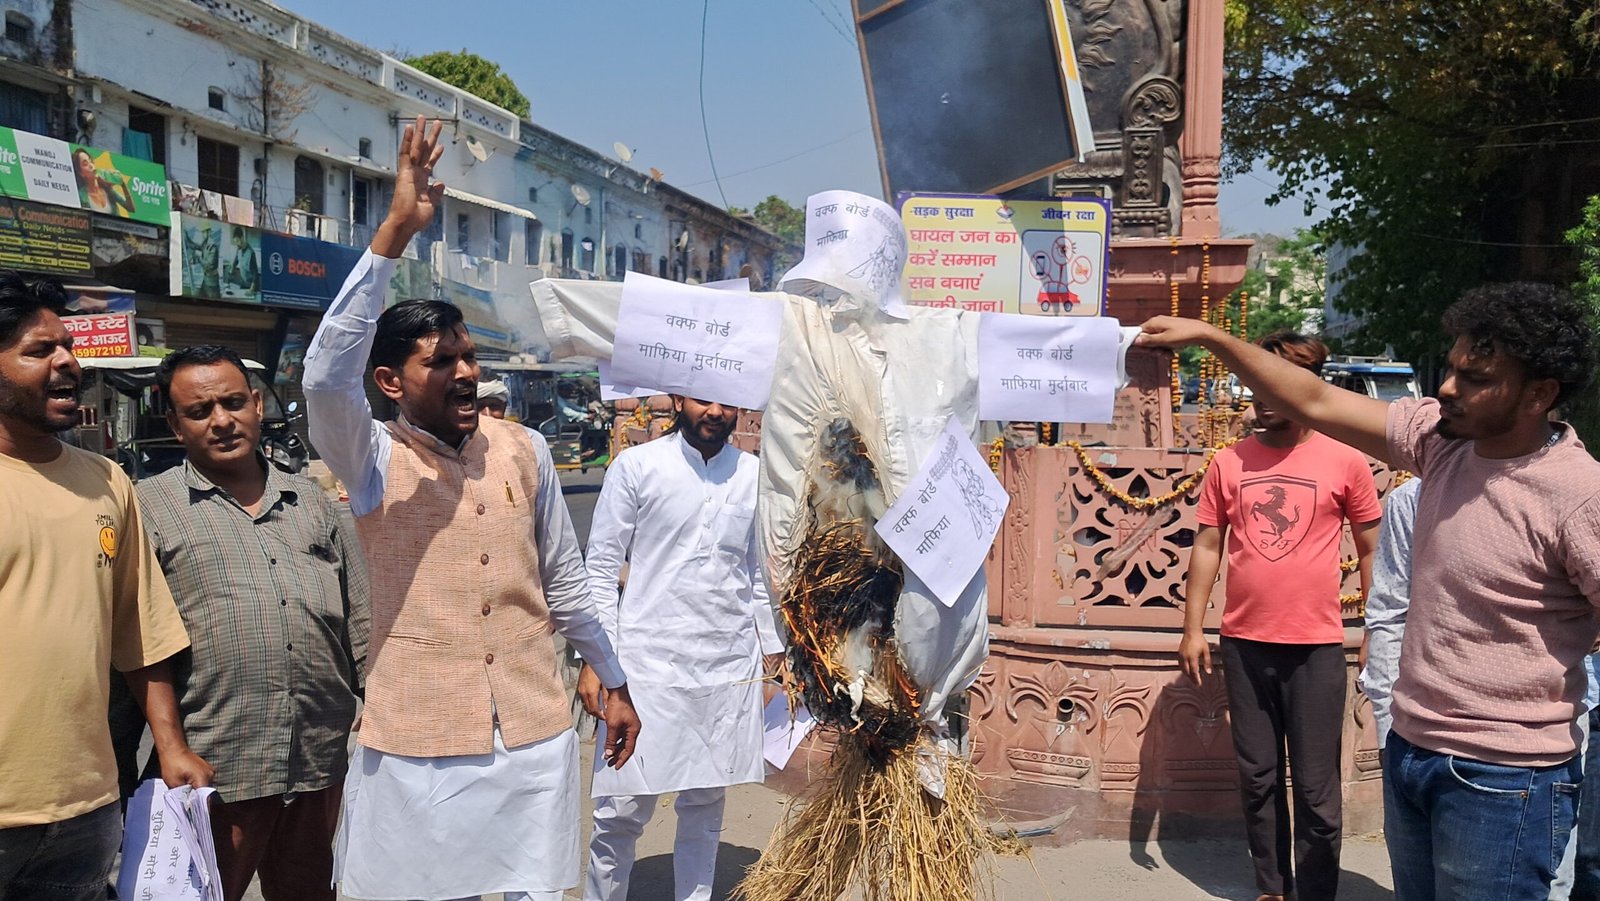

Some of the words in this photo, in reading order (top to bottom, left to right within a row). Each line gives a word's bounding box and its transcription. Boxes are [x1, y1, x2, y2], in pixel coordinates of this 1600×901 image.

[34, 148, 56, 159] MANOJ
[22, 155, 73, 172] COMMUNICATION
[33, 178, 50, 188] DAILY
[51, 181, 70, 192] NEEDS
[132, 176, 166, 197] Sprite
[18, 206, 90, 230] Communication
[815, 203, 839, 217] वक्फ
[845, 202, 870, 218] बोर्ड
[912, 206, 940, 219] सड़क
[944, 207, 974, 220] सुरक्षा
[1041, 208, 1070, 220] जीवन
[1075, 210, 1096, 220] रक्षा
[816, 229, 849, 247] माफिया
[910, 229, 954, 243] घायल
[960, 230, 990, 244] जन
[995, 230, 1017, 244] का
[909, 249, 939, 266] करें
[941, 253, 997, 267] सम्मान
[288, 258, 325, 278] BOSCH
[909, 276, 935, 289] सब
[941, 273, 984, 290] बचाएं
[96, 316, 126, 330] स्टेट
[666, 314, 698, 331] वक्फ
[705, 318, 731, 337] बोर्ड
[91, 333, 127, 346] आऊट
[639, 342, 687, 363] माफिया
[691, 352, 744, 373] मुर्दाबाद
[1017, 347, 1043, 360] वक्फ
[1050, 345, 1074, 360] बोर्ड
[1001, 375, 1042, 391] माफिया
[1048, 376, 1088, 395] मुर्दाबाद
[892, 505, 917, 533] वक्फ
[917, 478, 937, 505] बोर्ड
[916, 515, 951, 555] माफिया
[150, 810, 164, 848] शुक्रिया
[144, 854, 159, 880] मोदी
